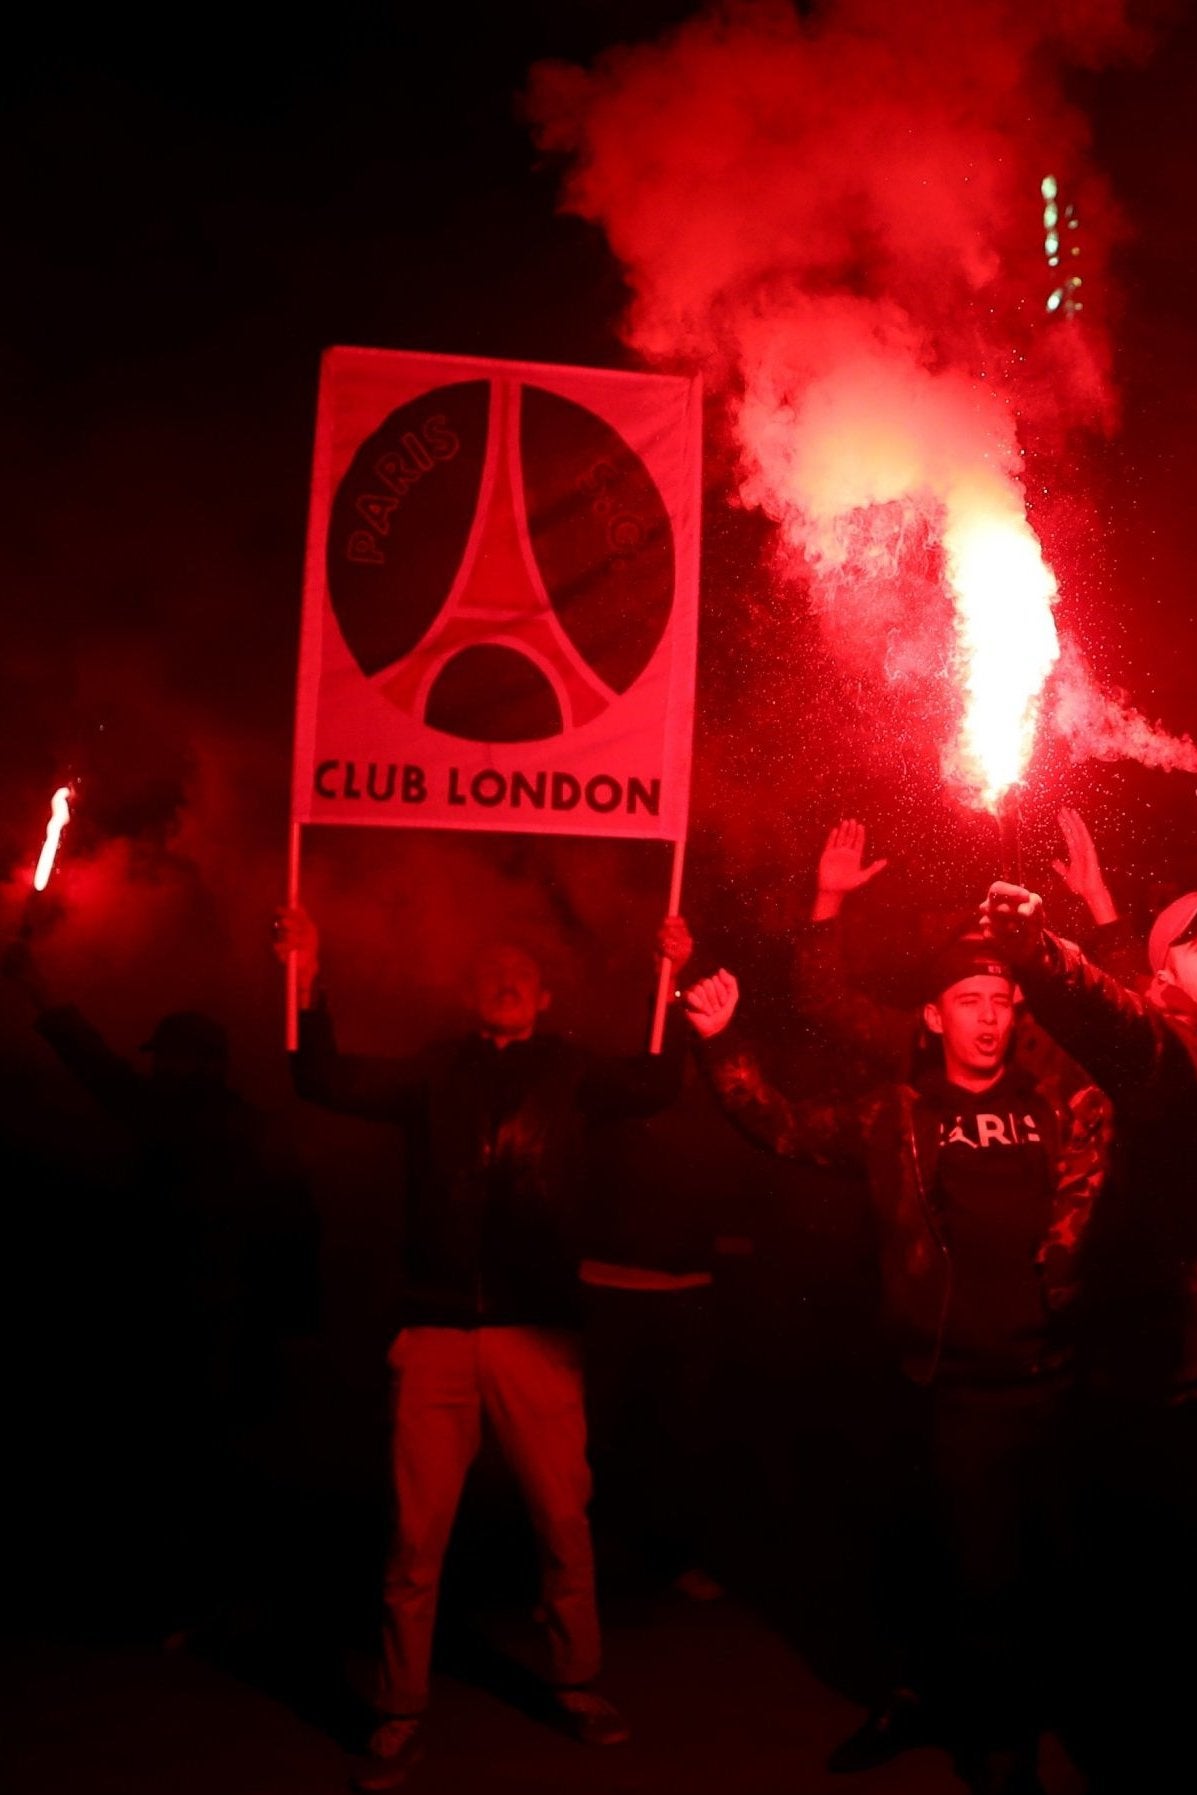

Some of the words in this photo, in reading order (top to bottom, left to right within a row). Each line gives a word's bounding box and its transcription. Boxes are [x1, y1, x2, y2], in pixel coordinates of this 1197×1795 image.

[345, 413, 462, 567] PARIS
[314, 759, 428, 801] CLUB
[448, 766, 662, 817] LONDON
